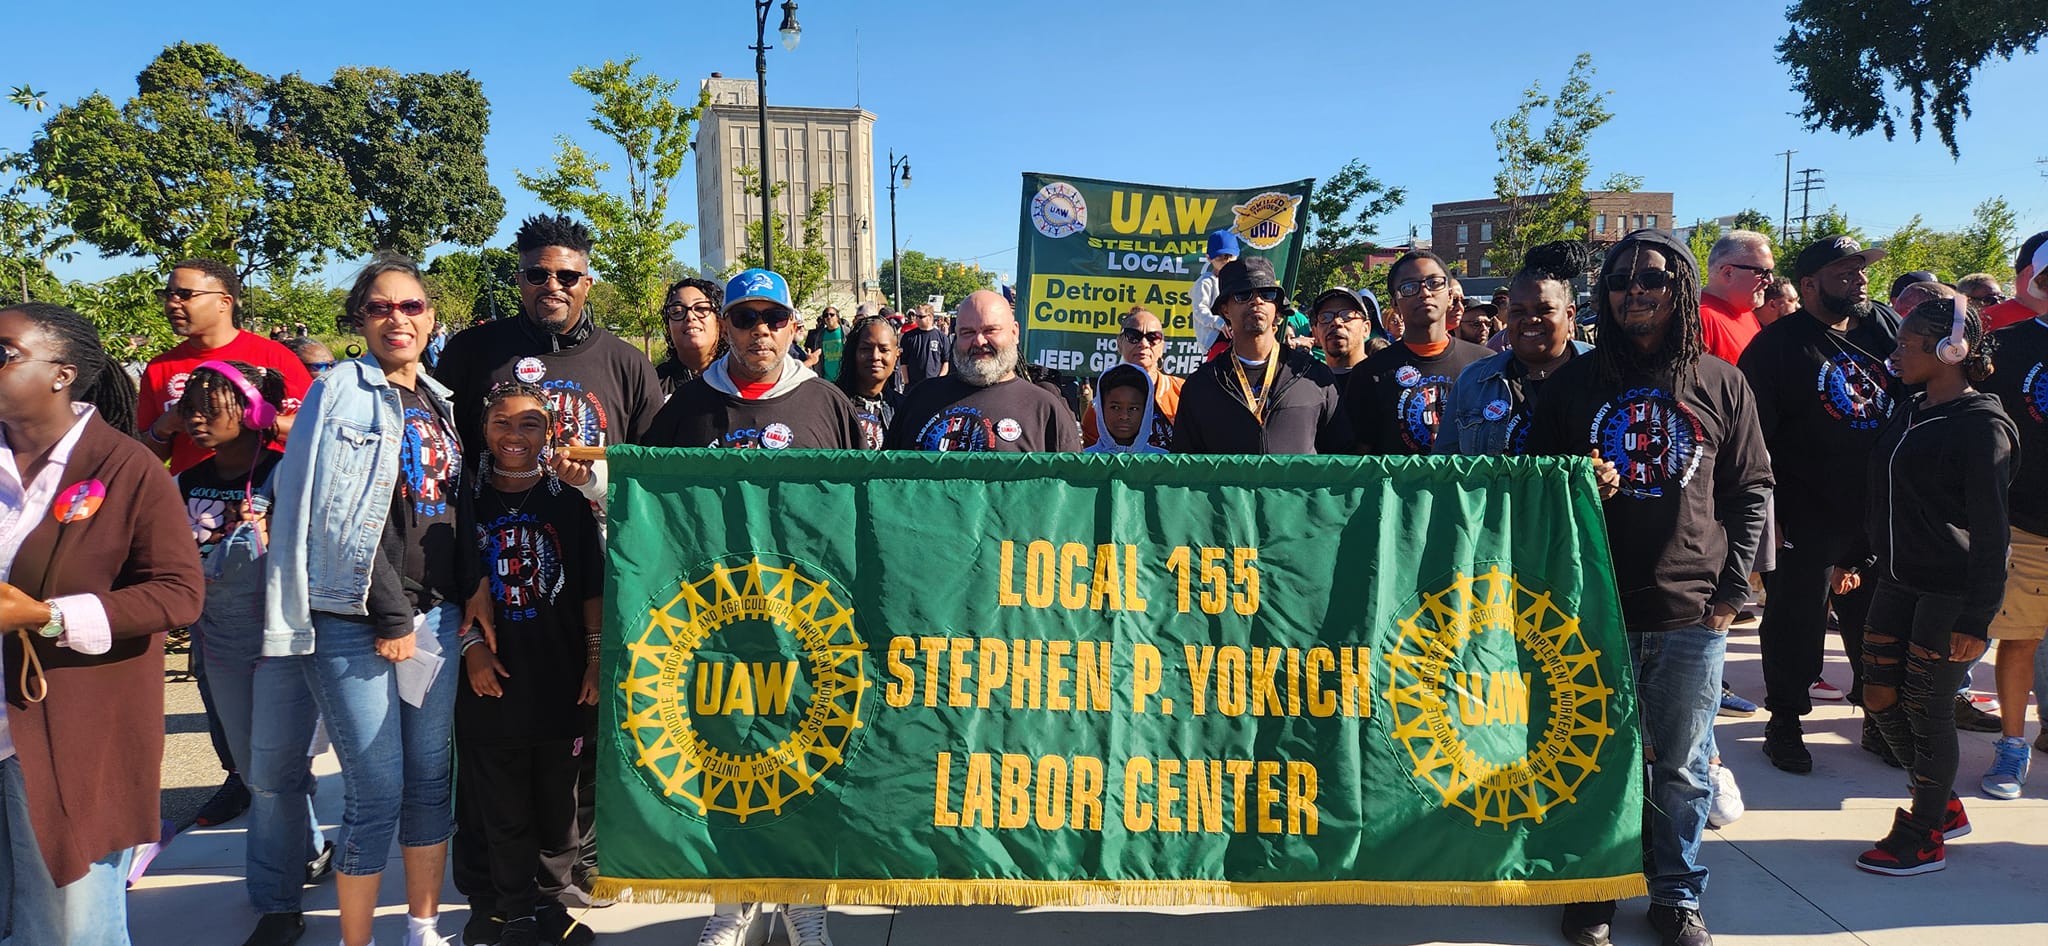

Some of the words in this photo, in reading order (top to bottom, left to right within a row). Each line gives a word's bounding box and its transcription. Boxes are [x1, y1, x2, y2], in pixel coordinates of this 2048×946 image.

[1050, 205, 1069, 219] UAW
[1110, 190, 1219, 236] UAW
[1250, 221, 1280, 238] UAW
[1087, 236, 1208, 255] STELLANT
[1108, 252, 1190, 274] LOCAL
[1046, 278, 1137, 304] Detroit
[1144, 283, 1193, 306] Ass
[1034, 301, 1127, 329] Comple
[1162, 308, 1194, 329] Jef
[1034, 349, 1085, 371] JEEP
[542, 379, 583, 392] OCAL
[1617, 387, 1673, 402] LOCAL
[945, 406, 983, 417] LOCAL
[1000, 540, 1147, 611] LOCAL
[1166, 546, 1260, 616] 155
[698, 609, 719, 630] AND
[721, 598, 794, 621] AGRICULTURAL
[662, 627, 697, 687] AEROSPACE
[798, 617, 833, 675] IMPLEMENT
[1525, 628, 1570, 685] IMPLEMENT
[695, 661, 799, 716] UAW
[885, 635, 1112, 713] STEPHEN
[1132, 643, 1172, 716] P.
[1185, 645, 1371, 719] YOKICH
[807, 680, 833, 733] WORKERS
[1456, 671, 1531, 727] UAW
[1554, 690, 1574, 744] WORKERS
[799, 734, 811, 751] OF
[1549, 744, 1561, 761] OF
[702, 756, 740, 778] UNITED
[751, 750, 795, 777] AMERICA
[933, 752, 1104, 832] LABOR
[1123, 756, 1319, 836] CENTER
